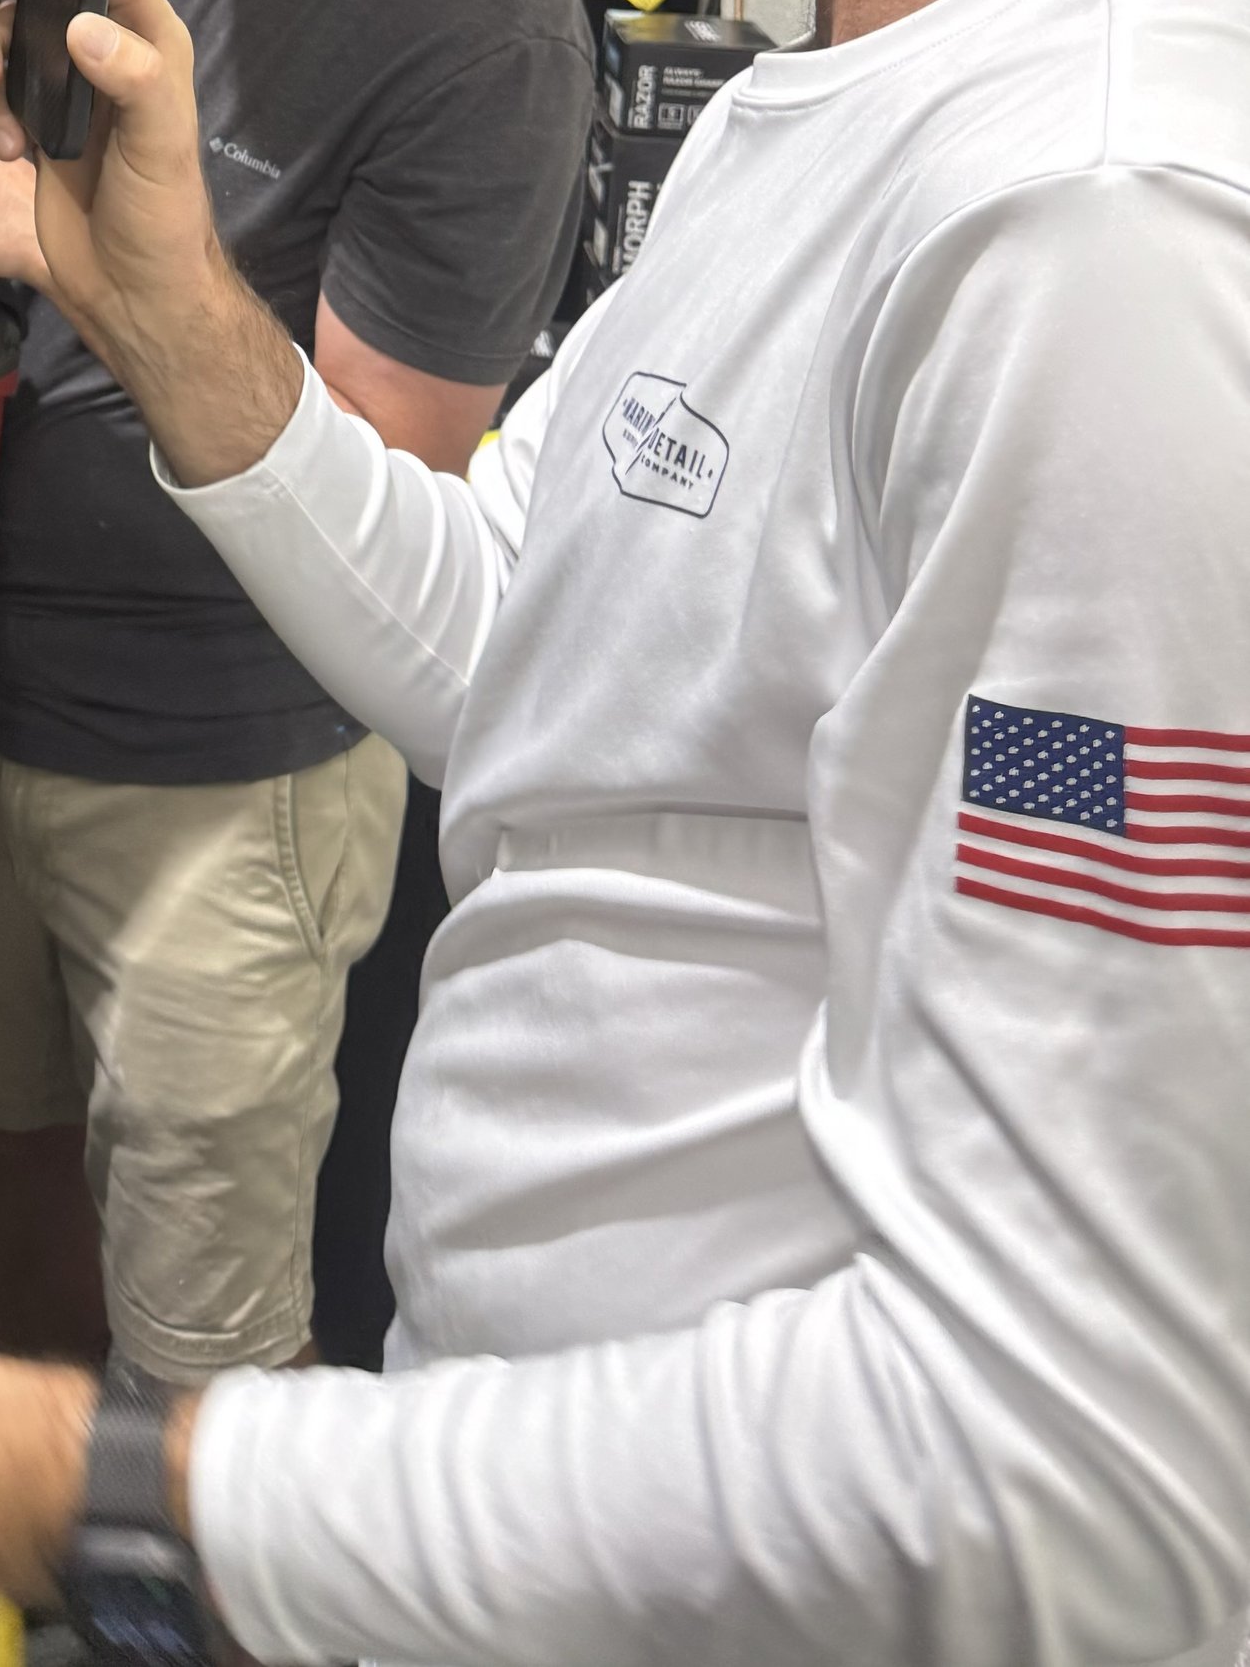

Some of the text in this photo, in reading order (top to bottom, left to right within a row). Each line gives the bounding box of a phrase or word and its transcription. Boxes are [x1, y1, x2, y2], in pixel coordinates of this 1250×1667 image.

[634, 65, 657, 129] RAZOR
[224, 142, 281, 179] Columbia
[622, 397, 656, 436] MARIN
